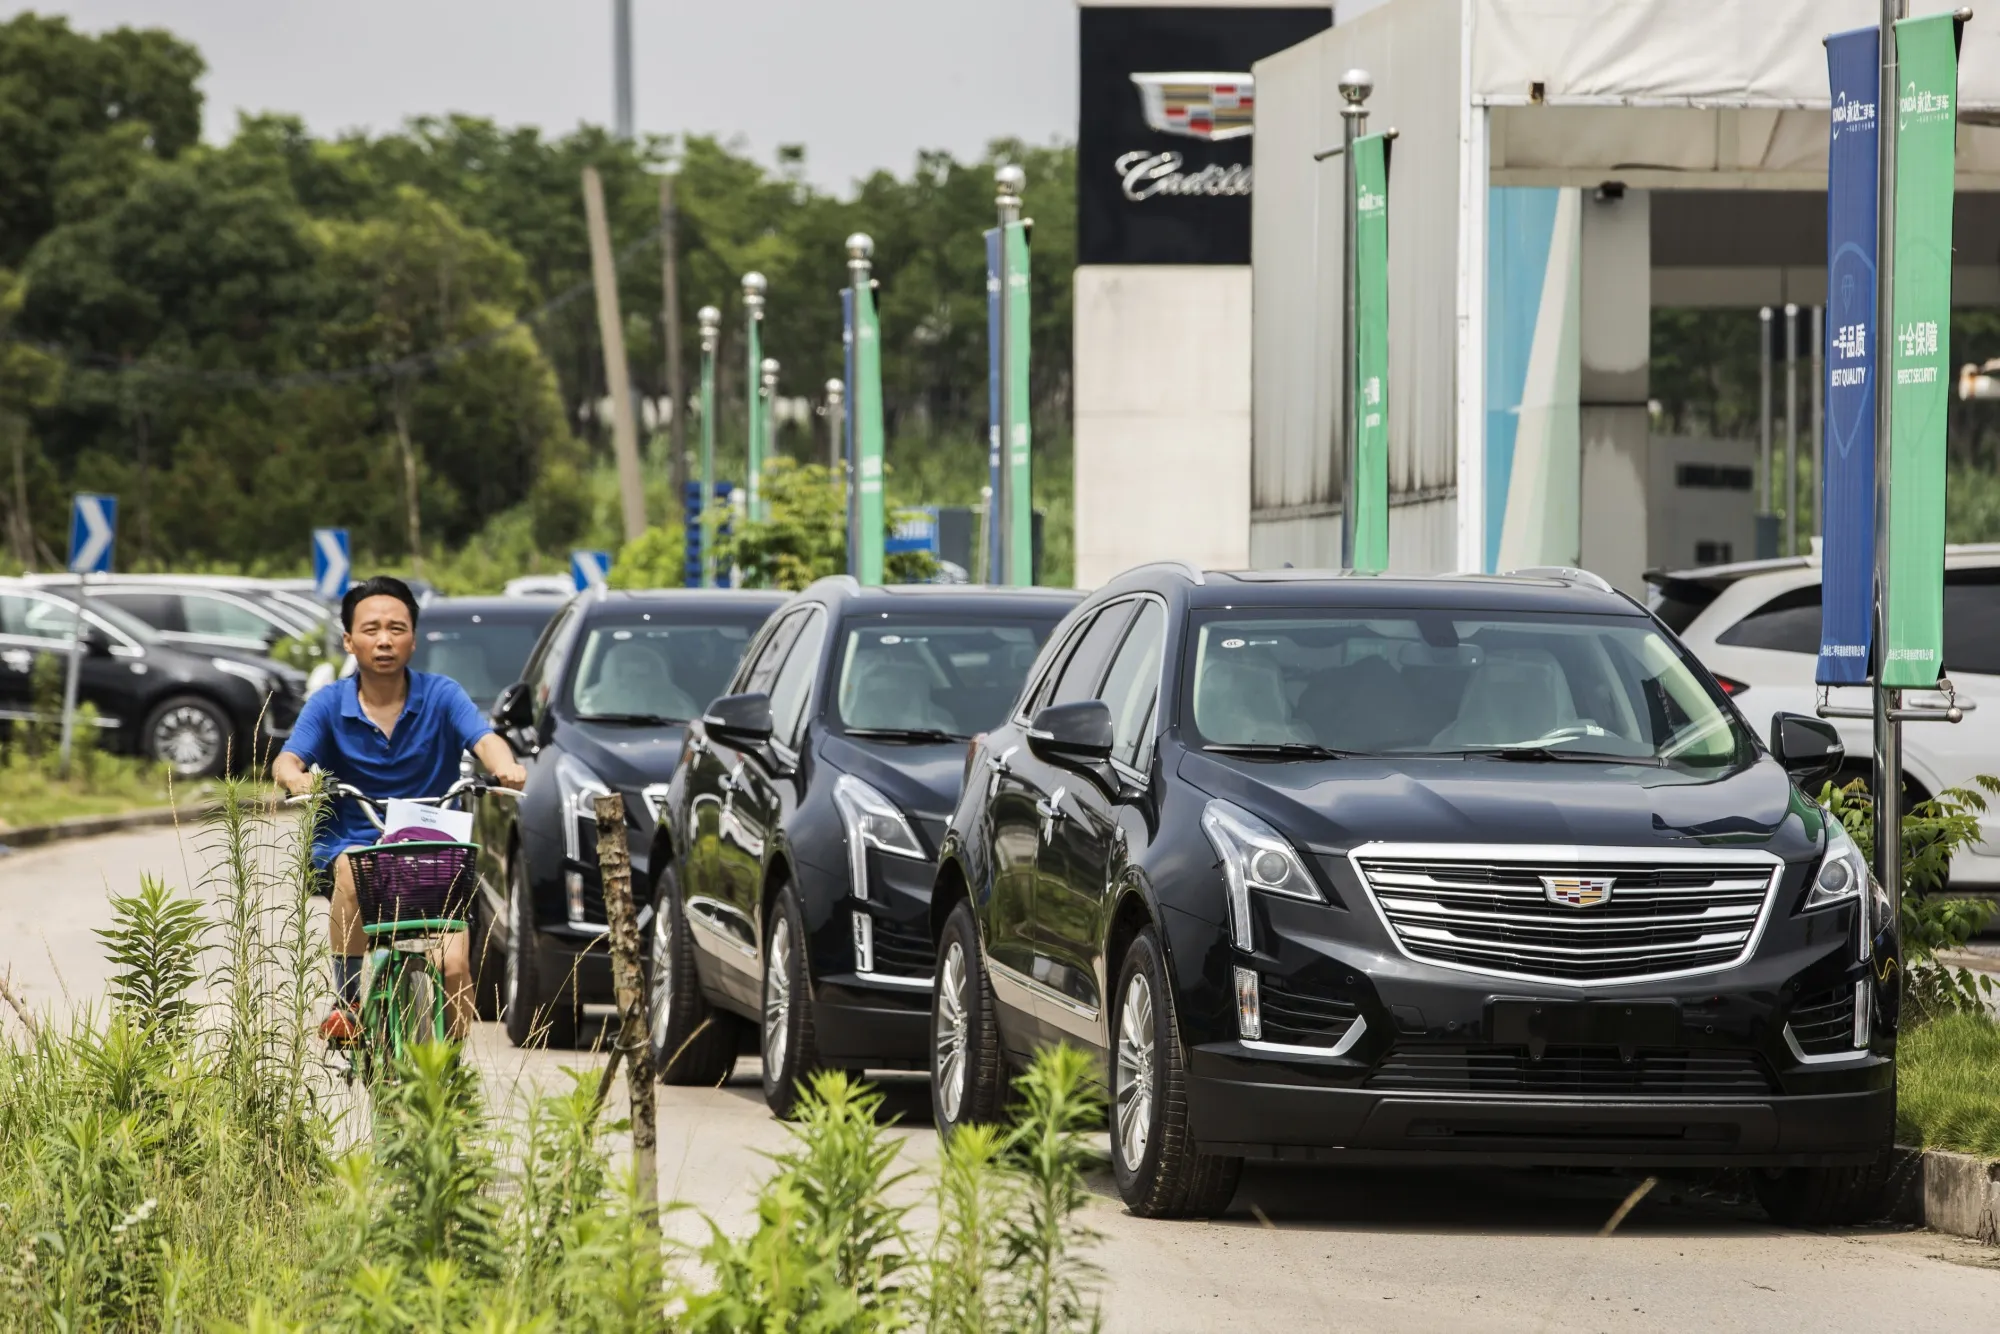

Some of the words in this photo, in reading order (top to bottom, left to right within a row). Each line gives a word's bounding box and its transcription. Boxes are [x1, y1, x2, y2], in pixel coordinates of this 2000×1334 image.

[1846, 100, 1875, 122] 永达二手车
[1832, 323, 1866, 359] 一手品质
[1898, 320, 1938, 357] 十全保障
[1832, 369, 1842, 387] BEST
[1842, 367, 1866, 387] QUALITY
[1913, 367, 1938, 383] SECURITY
